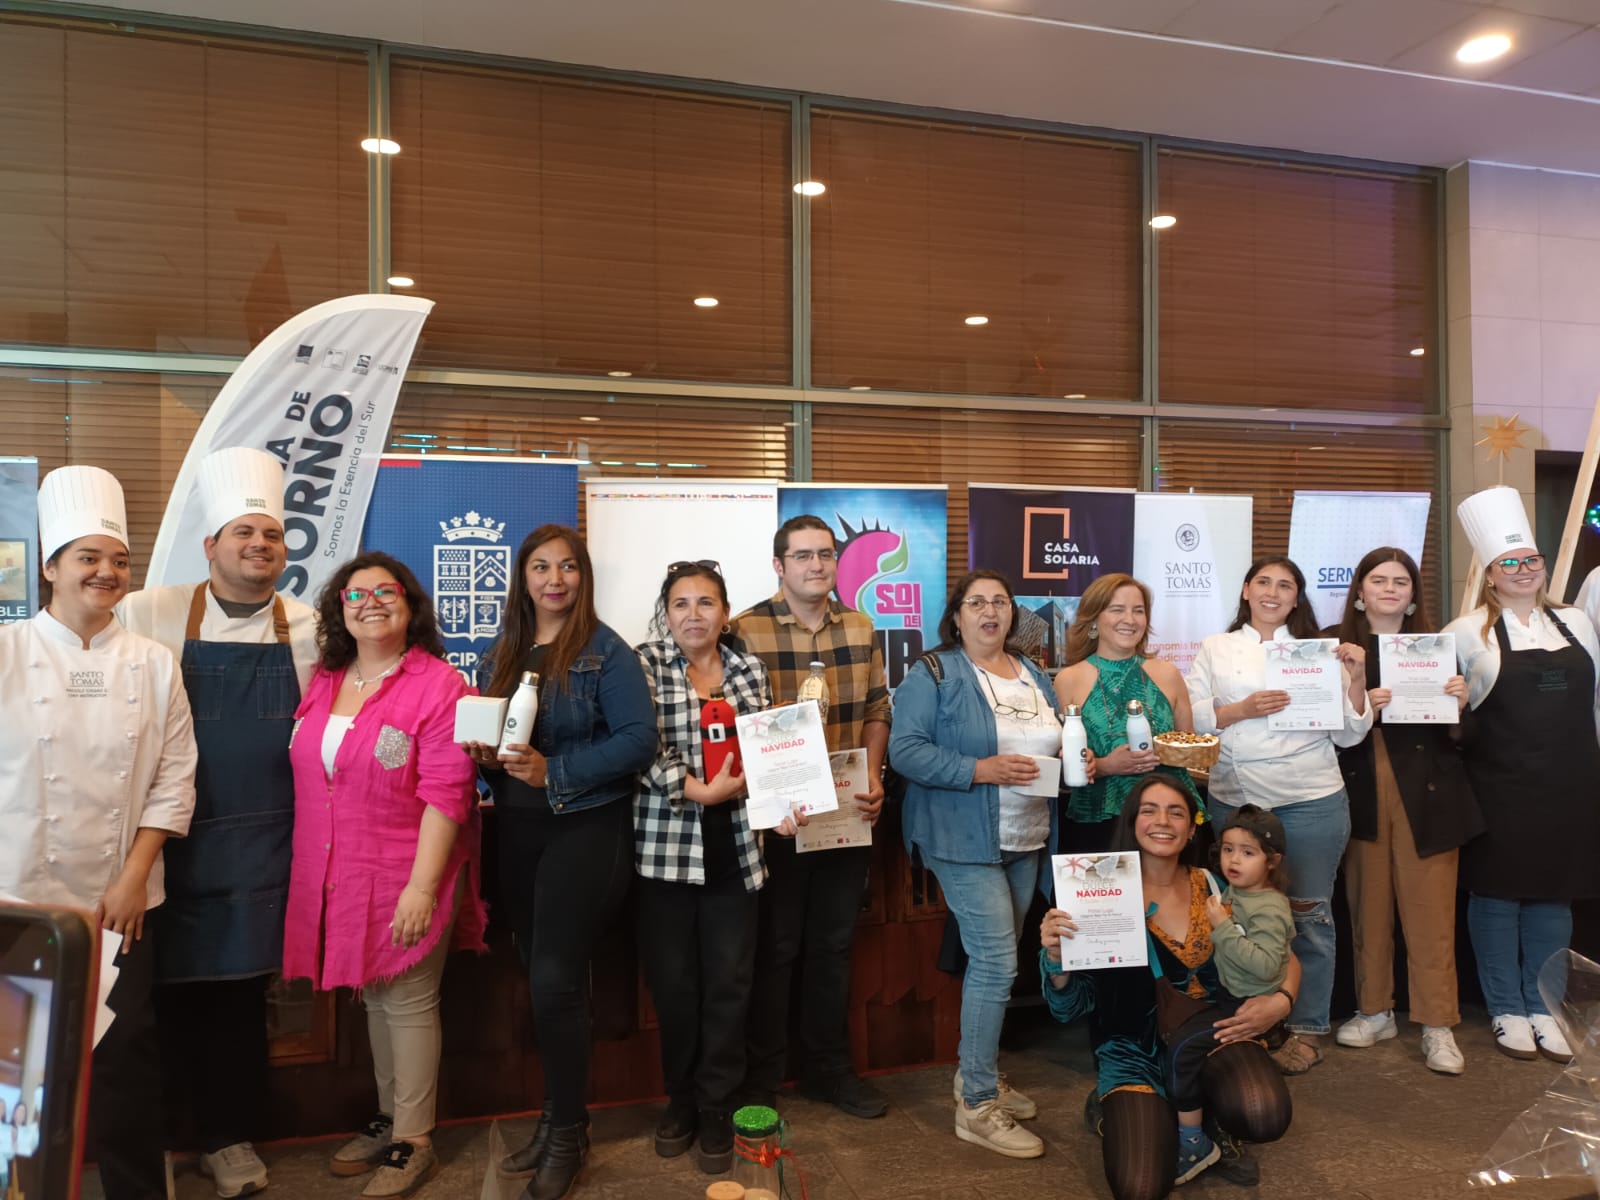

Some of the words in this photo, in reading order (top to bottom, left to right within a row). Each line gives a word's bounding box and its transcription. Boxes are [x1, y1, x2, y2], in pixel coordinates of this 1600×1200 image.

[285, 391, 311, 421] DE
[360, 400, 376, 421] Sur
[353, 424, 369, 444] del
[339, 447, 362, 497] Esencia
[335, 500, 349, 511] la
[323, 515, 345, 558] Somos
[1044, 542, 1079, 552] CASA
[1044, 554, 1100, 566] SOLARIA
[1165, 561, 1211, 575] SANTO
[1164, 574, 1212, 589] TOMÁS
[1282, 667, 1323, 675] NAVIDAD
[760, 738, 805, 754] NAVIDAD
[1076, 888, 1122, 898] NAVIDAD
